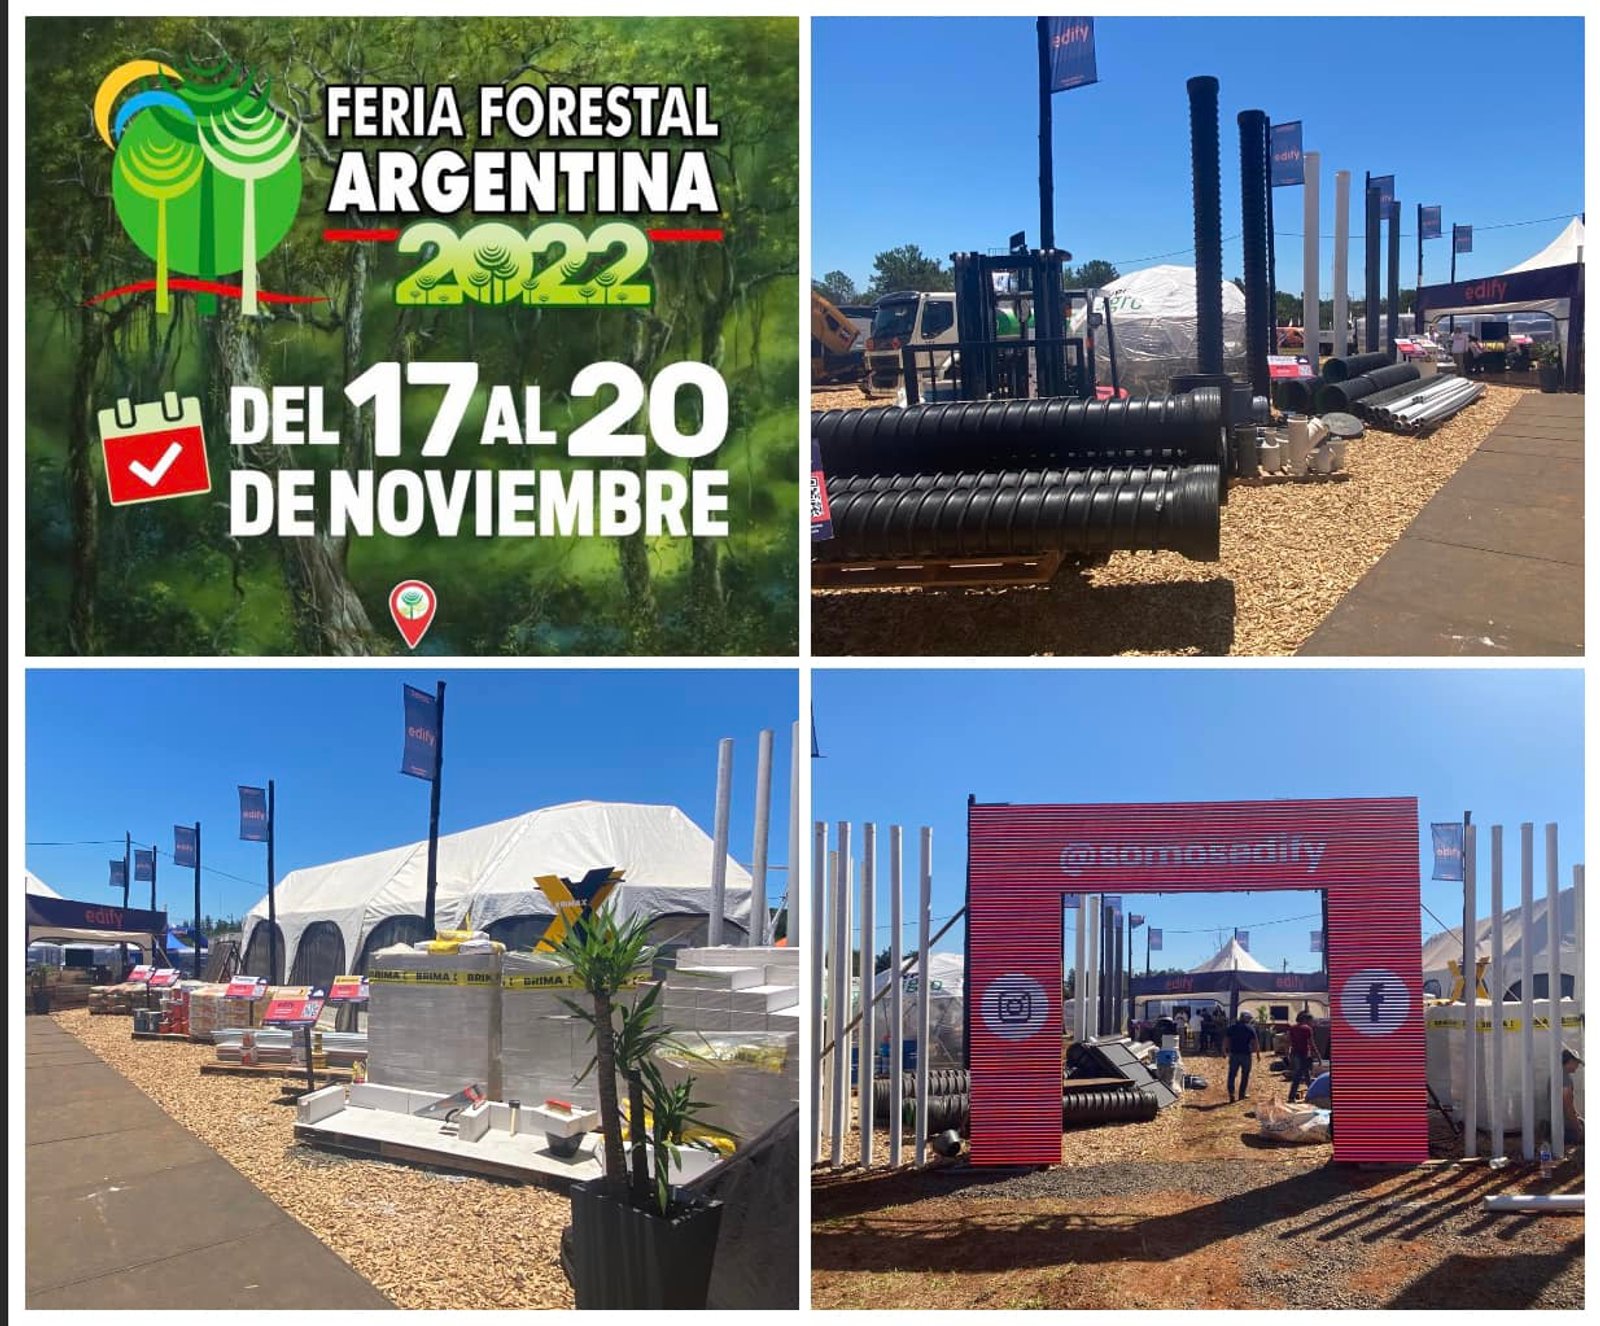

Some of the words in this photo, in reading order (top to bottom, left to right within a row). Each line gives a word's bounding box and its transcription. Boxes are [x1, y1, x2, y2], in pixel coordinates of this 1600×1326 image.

[1051, 25, 1088, 48] edify
[326, 86, 464, 137] FERIA
[479, 86, 719, 137] FORESTAL
[327, 150, 720, 213] ARGENTINA
[395, 222, 652, 306] 2022
[1464, 278, 1509, 302] edify
[230, 386, 340, 446] DEL
[343, 361, 479, 457] 17
[481, 386, 557, 446] AL
[567, 360, 730, 458] 20
[229, 469, 315, 537] DE
[330, 469, 730, 537] NOVIEMBRE
[408, 725, 436, 748] edify
[1059, 833, 1328, 876] @somosedify
[85, 907, 124, 929] edify
